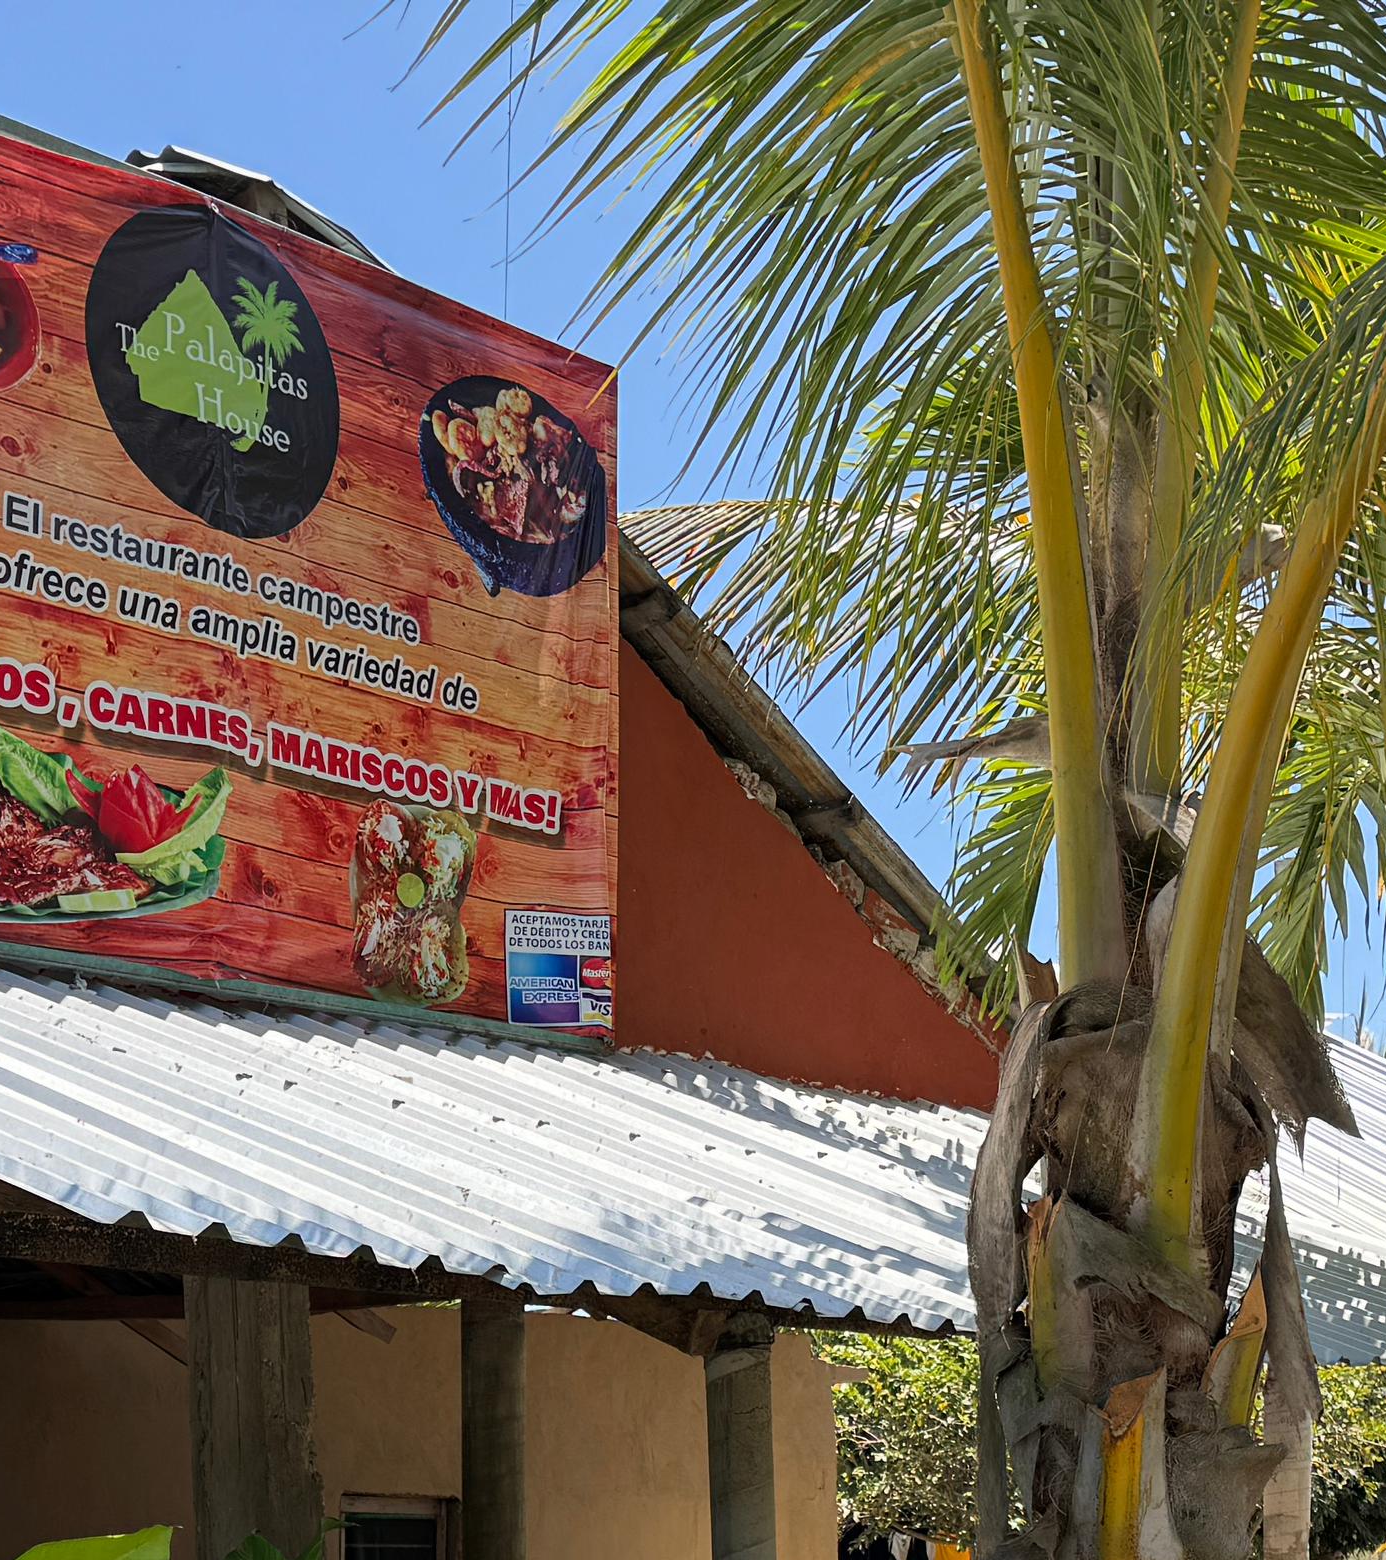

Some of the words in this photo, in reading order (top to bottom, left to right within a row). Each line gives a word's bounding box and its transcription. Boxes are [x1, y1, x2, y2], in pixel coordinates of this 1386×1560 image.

[115, 322, 160, 362] The
[162, 310, 308, 400] Palapitas
[194, 382, 291, 453] House
[7, 495, 41, 535] El
[53, 515, 251, 592] restaurante
[259, 575, 419, 644] campestre
[119, 588, 179, 630] una
[192, 608, 297, 662] amplia
[307, 639, 435, 699] variedad
[442, 675, 478, 710] de
[89, 686, 260, 761] CARNES,
[271, 728, 449, 801] MARISCOS
[457, 775, 479, 808] Y
[490, 784, 558, 830] MAS!
[511, 914, 577, 928] ACEPTAMOS
[514, 926, 528, 936] DE
[530, 925, 570, 938] DÉBITO
[572, 929, 580, 938] Y
[509, 937, 523, 947] DE
[525, 938, 562, 949] TODOS
[565, 940, 585, 950] LOS
[510, 977, 575, 990] AMERICAN
[524, 991, 580, 1003] EXPRESS
[590, 1000, 612, 1017] VIS
